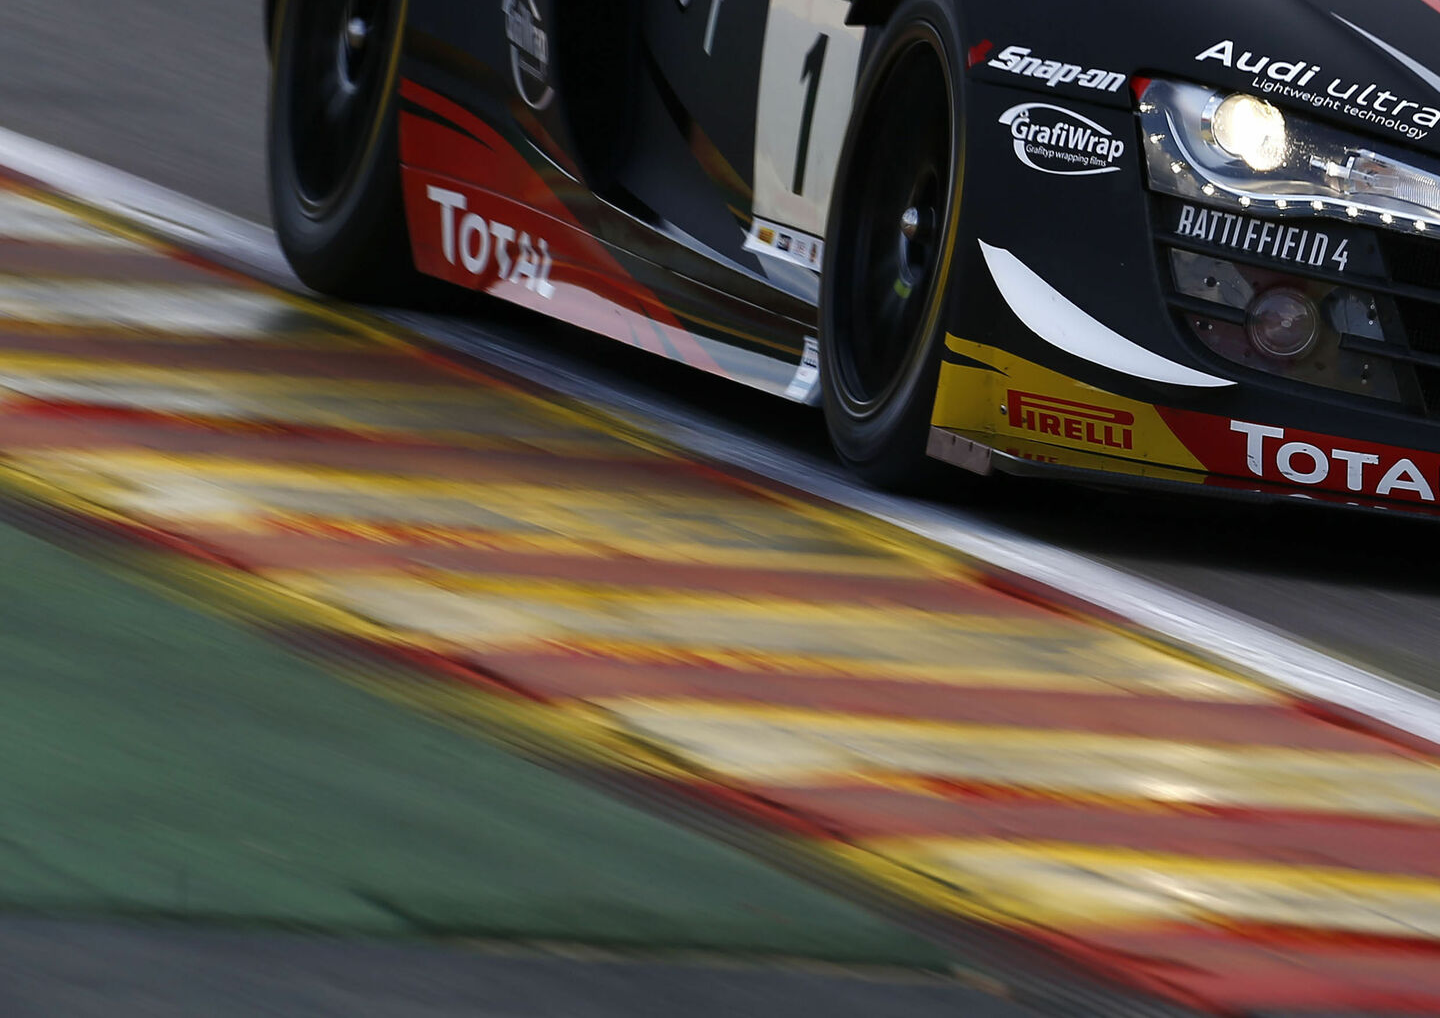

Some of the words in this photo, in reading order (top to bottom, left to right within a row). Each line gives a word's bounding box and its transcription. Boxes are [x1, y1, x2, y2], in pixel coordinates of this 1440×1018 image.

[987, 45, 1126, 93] Snap-on
[1195, 39, 1321, 87] Audi
[790, 32, 829, 197] 1
[1011, 115, 1125, 162] GrafiWrap
[1252, 76, 1341, 110] Lightweight
[1343, 104, 1428, 140] technology
[1055, 150, 1089, 166] wrapping
[427, 184, 557, 300] TOTAL
[1177, 204, 1328, 266] BATTLEFIELD
[1331, 239, 1349, 271] 4
[1007, 388, 1135, 450] PIRELLI
